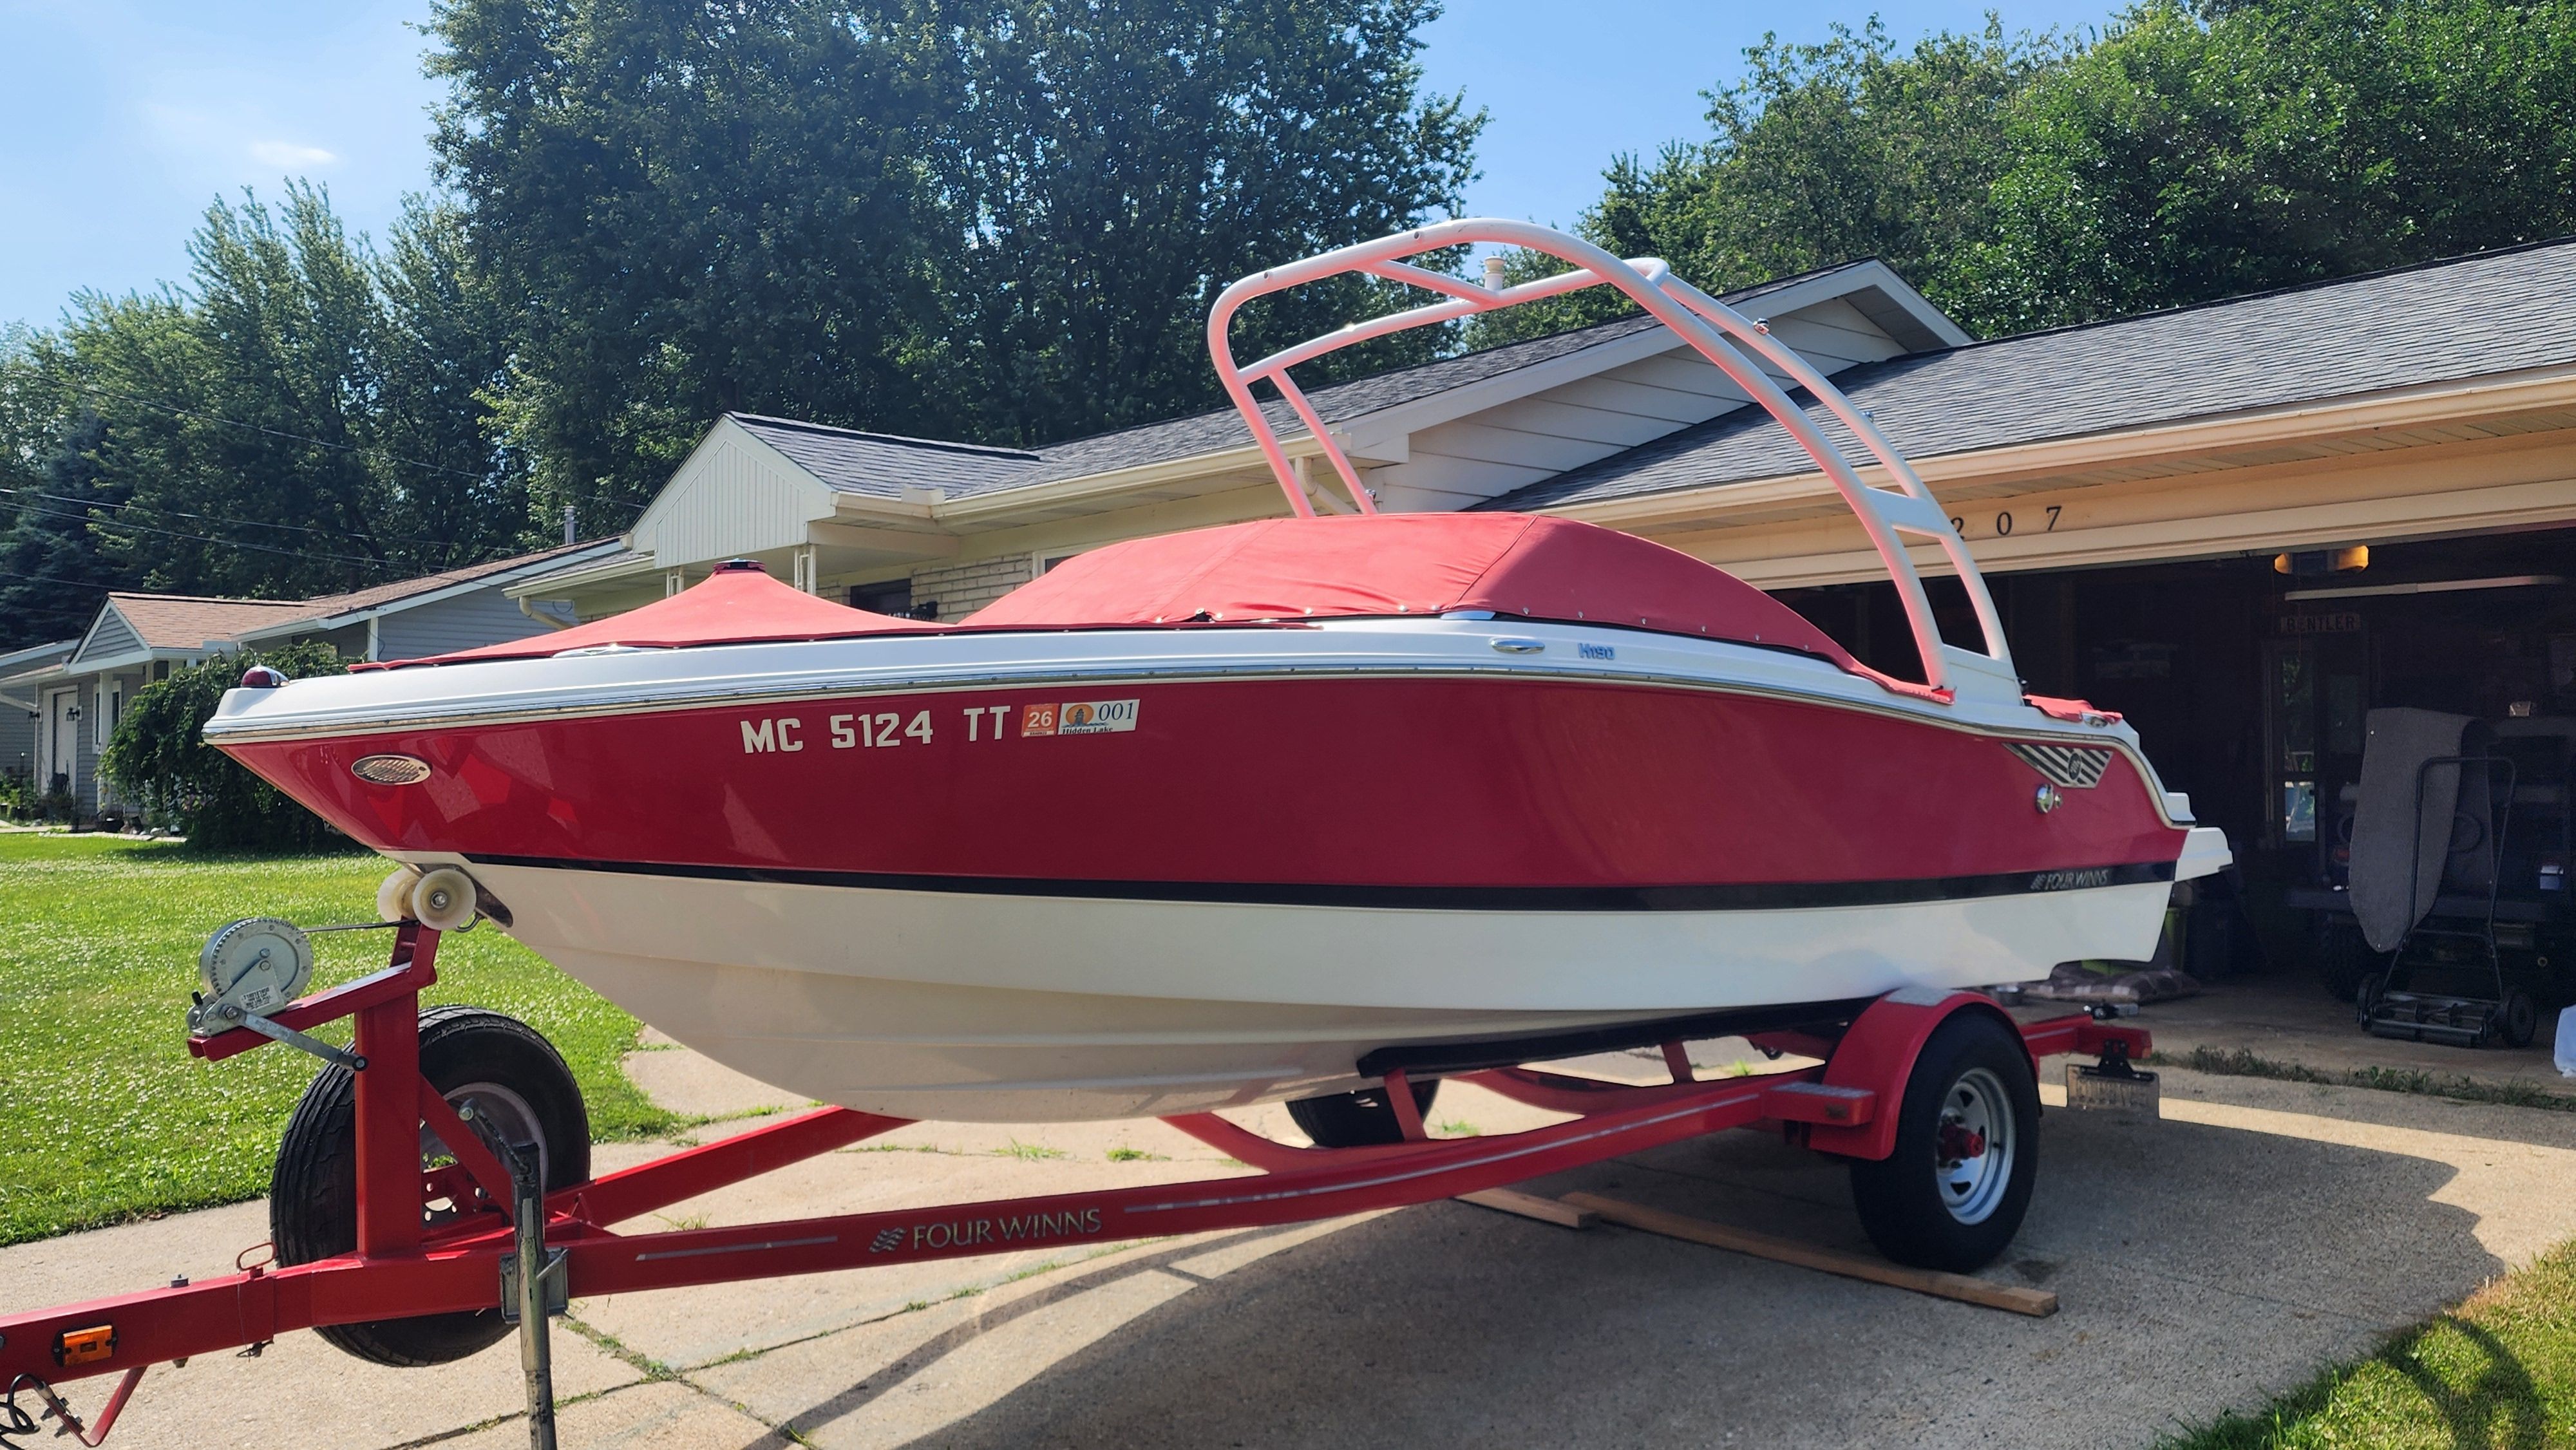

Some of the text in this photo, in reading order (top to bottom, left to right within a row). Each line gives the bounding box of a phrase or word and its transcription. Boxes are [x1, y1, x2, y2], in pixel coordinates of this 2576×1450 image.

[1028, 711, 1053, 728] 26
[1099, 702, 1133, 721] 001
[740, 705, 1011, 754] MC 5124 TT
[1063, 726, 1091, 735] Hidden
[2045, 870, 2108, 890] FOUR WINNS
[913, 1208, 1103, 1251] FOUR WINNS
